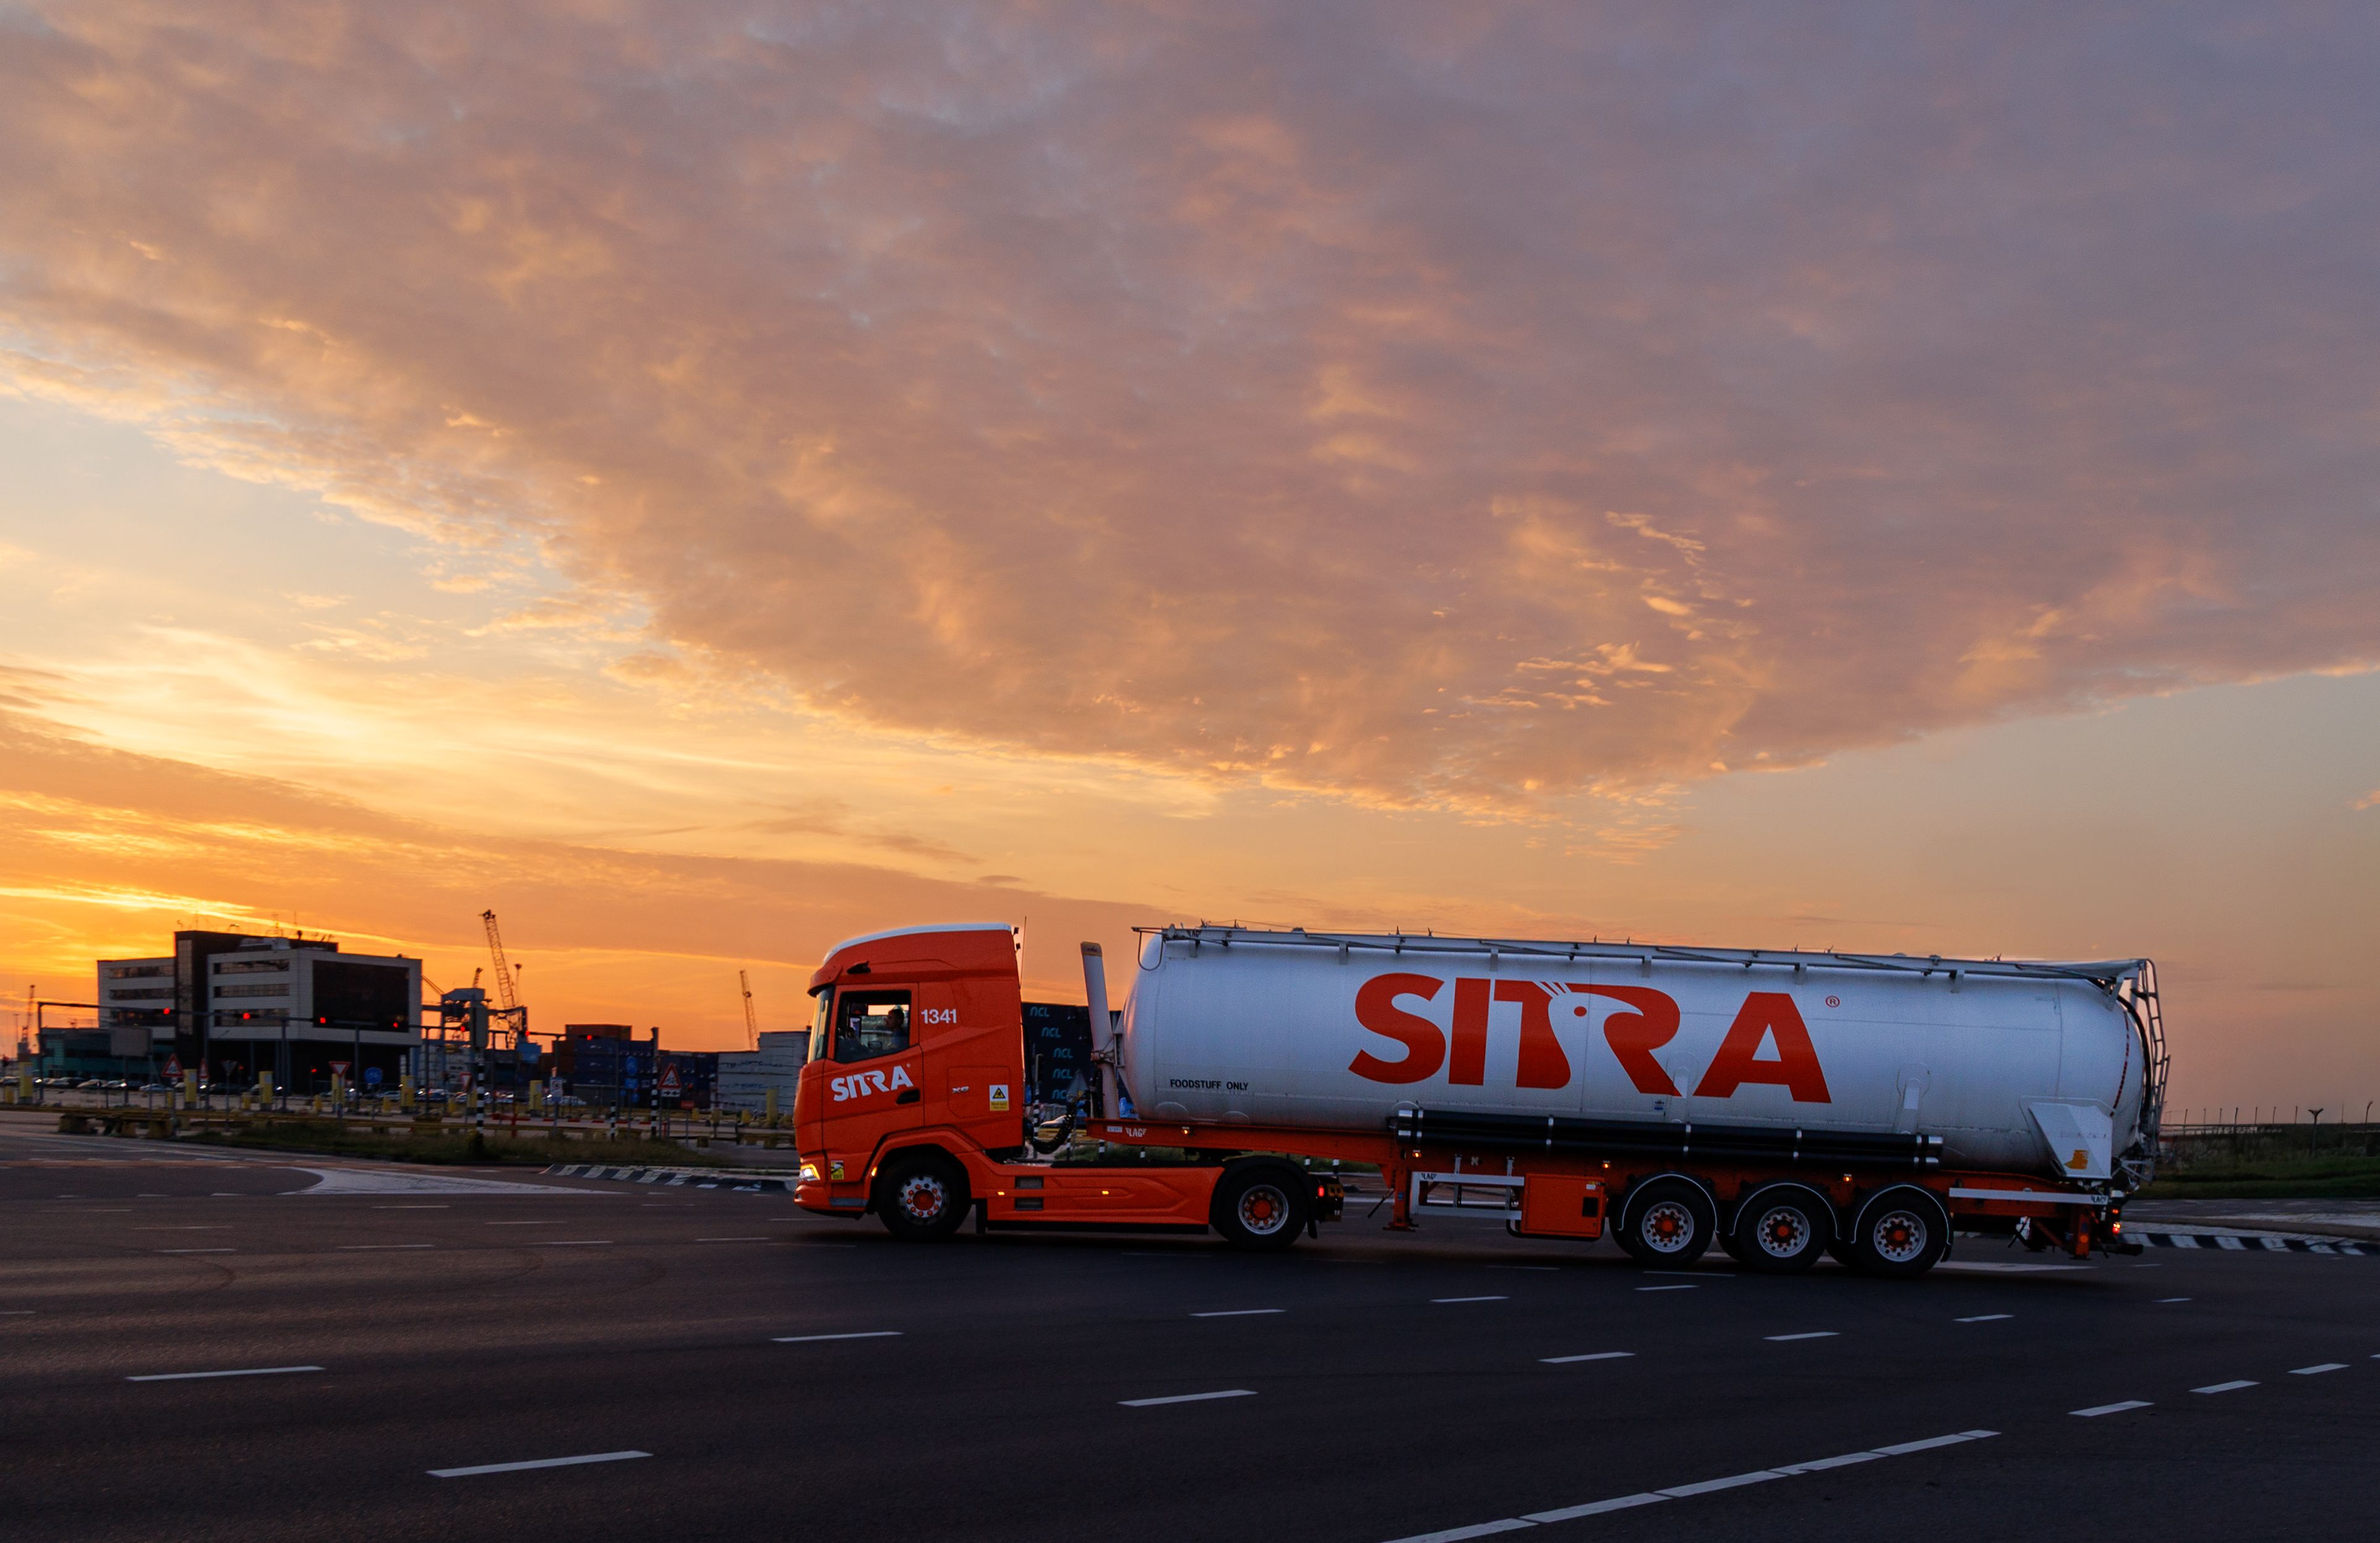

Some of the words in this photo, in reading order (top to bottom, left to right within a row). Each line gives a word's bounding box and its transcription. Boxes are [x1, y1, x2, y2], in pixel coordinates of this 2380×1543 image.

[921, 1008, 957, 1025] 1341
[1348, 973, 1833, 1104] SITRA
[831, 1065, 914, 1102] SITRA
[1170, 1078, 1222, 1090] FOODSTUFF
[1226, 1081, 1249, 1091] ONLY
